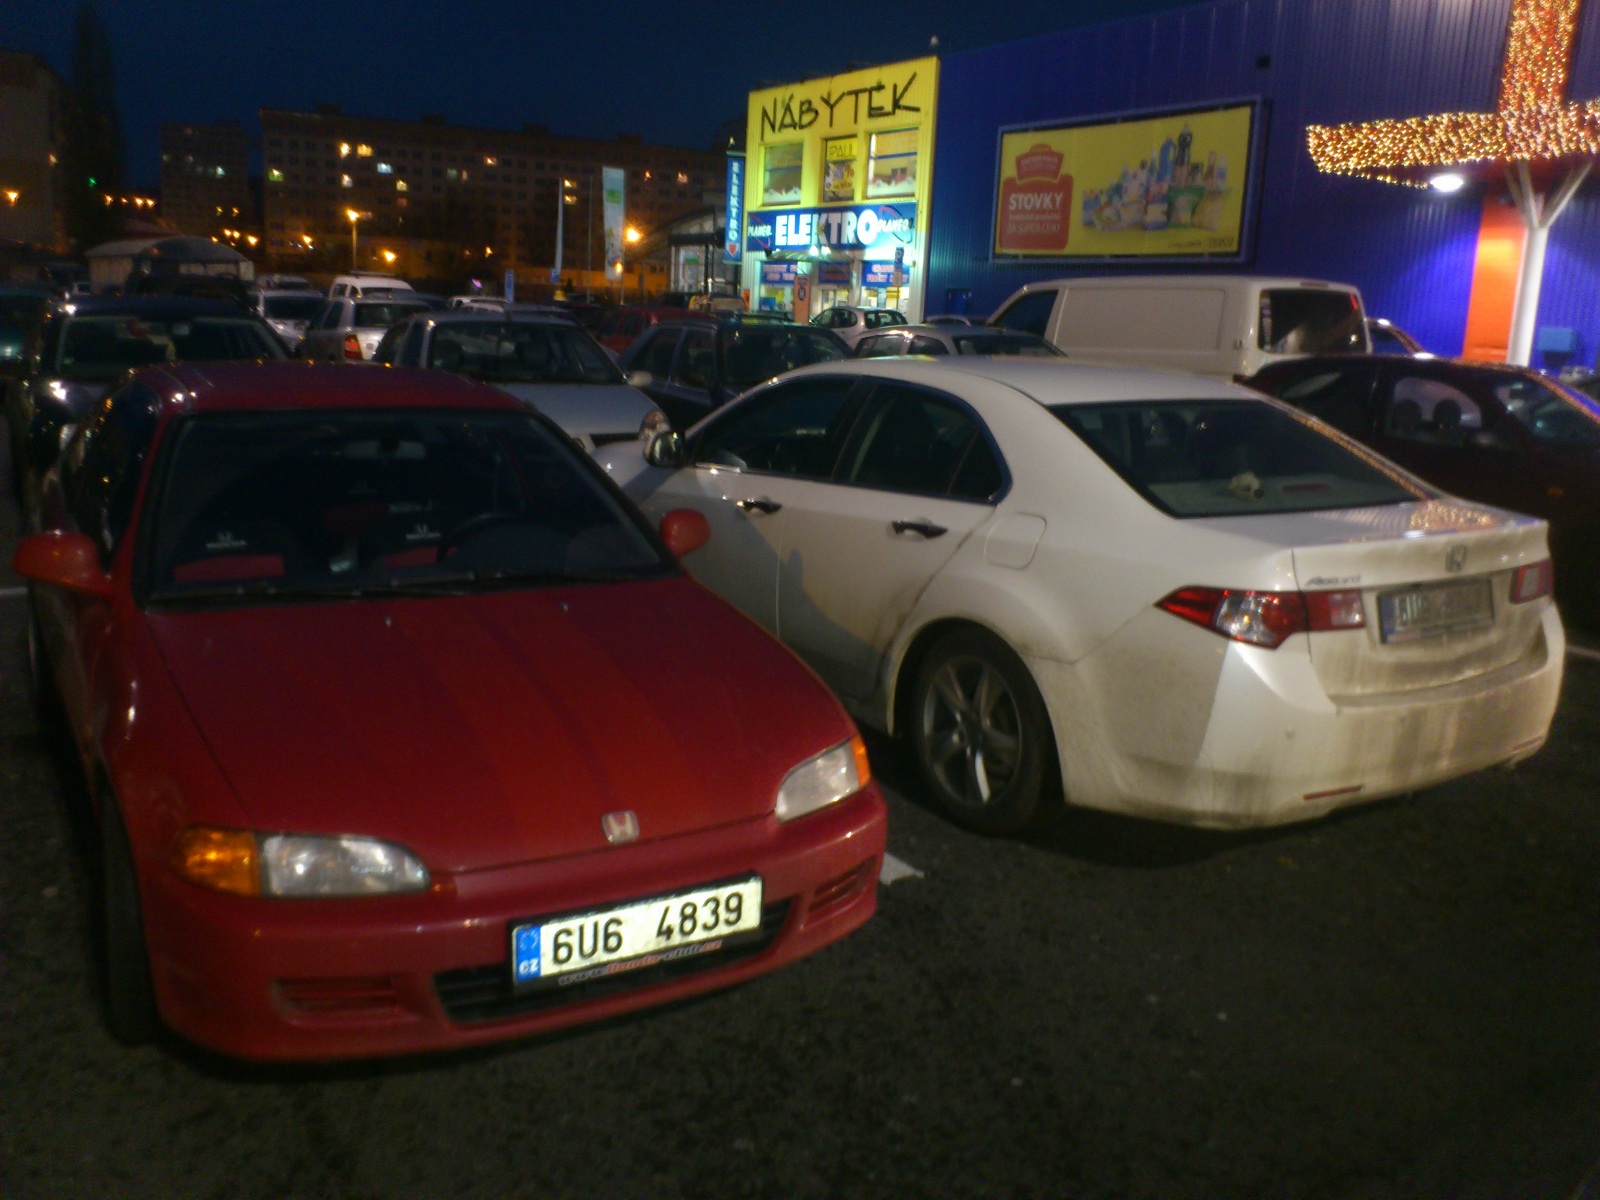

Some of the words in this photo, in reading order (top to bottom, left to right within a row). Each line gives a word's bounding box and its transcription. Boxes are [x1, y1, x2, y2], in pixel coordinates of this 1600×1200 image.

[760, 72, 921, 142] NÁBYTEK
[728, 161, 740, 241] ELEKTRO
[775, 209, 878, 246] ELEKTRO
[1009, 192, 1064, 211] STOVKY
[552, 917, 624, 965] 6U6
[656, 891, 744, 941] 4839
